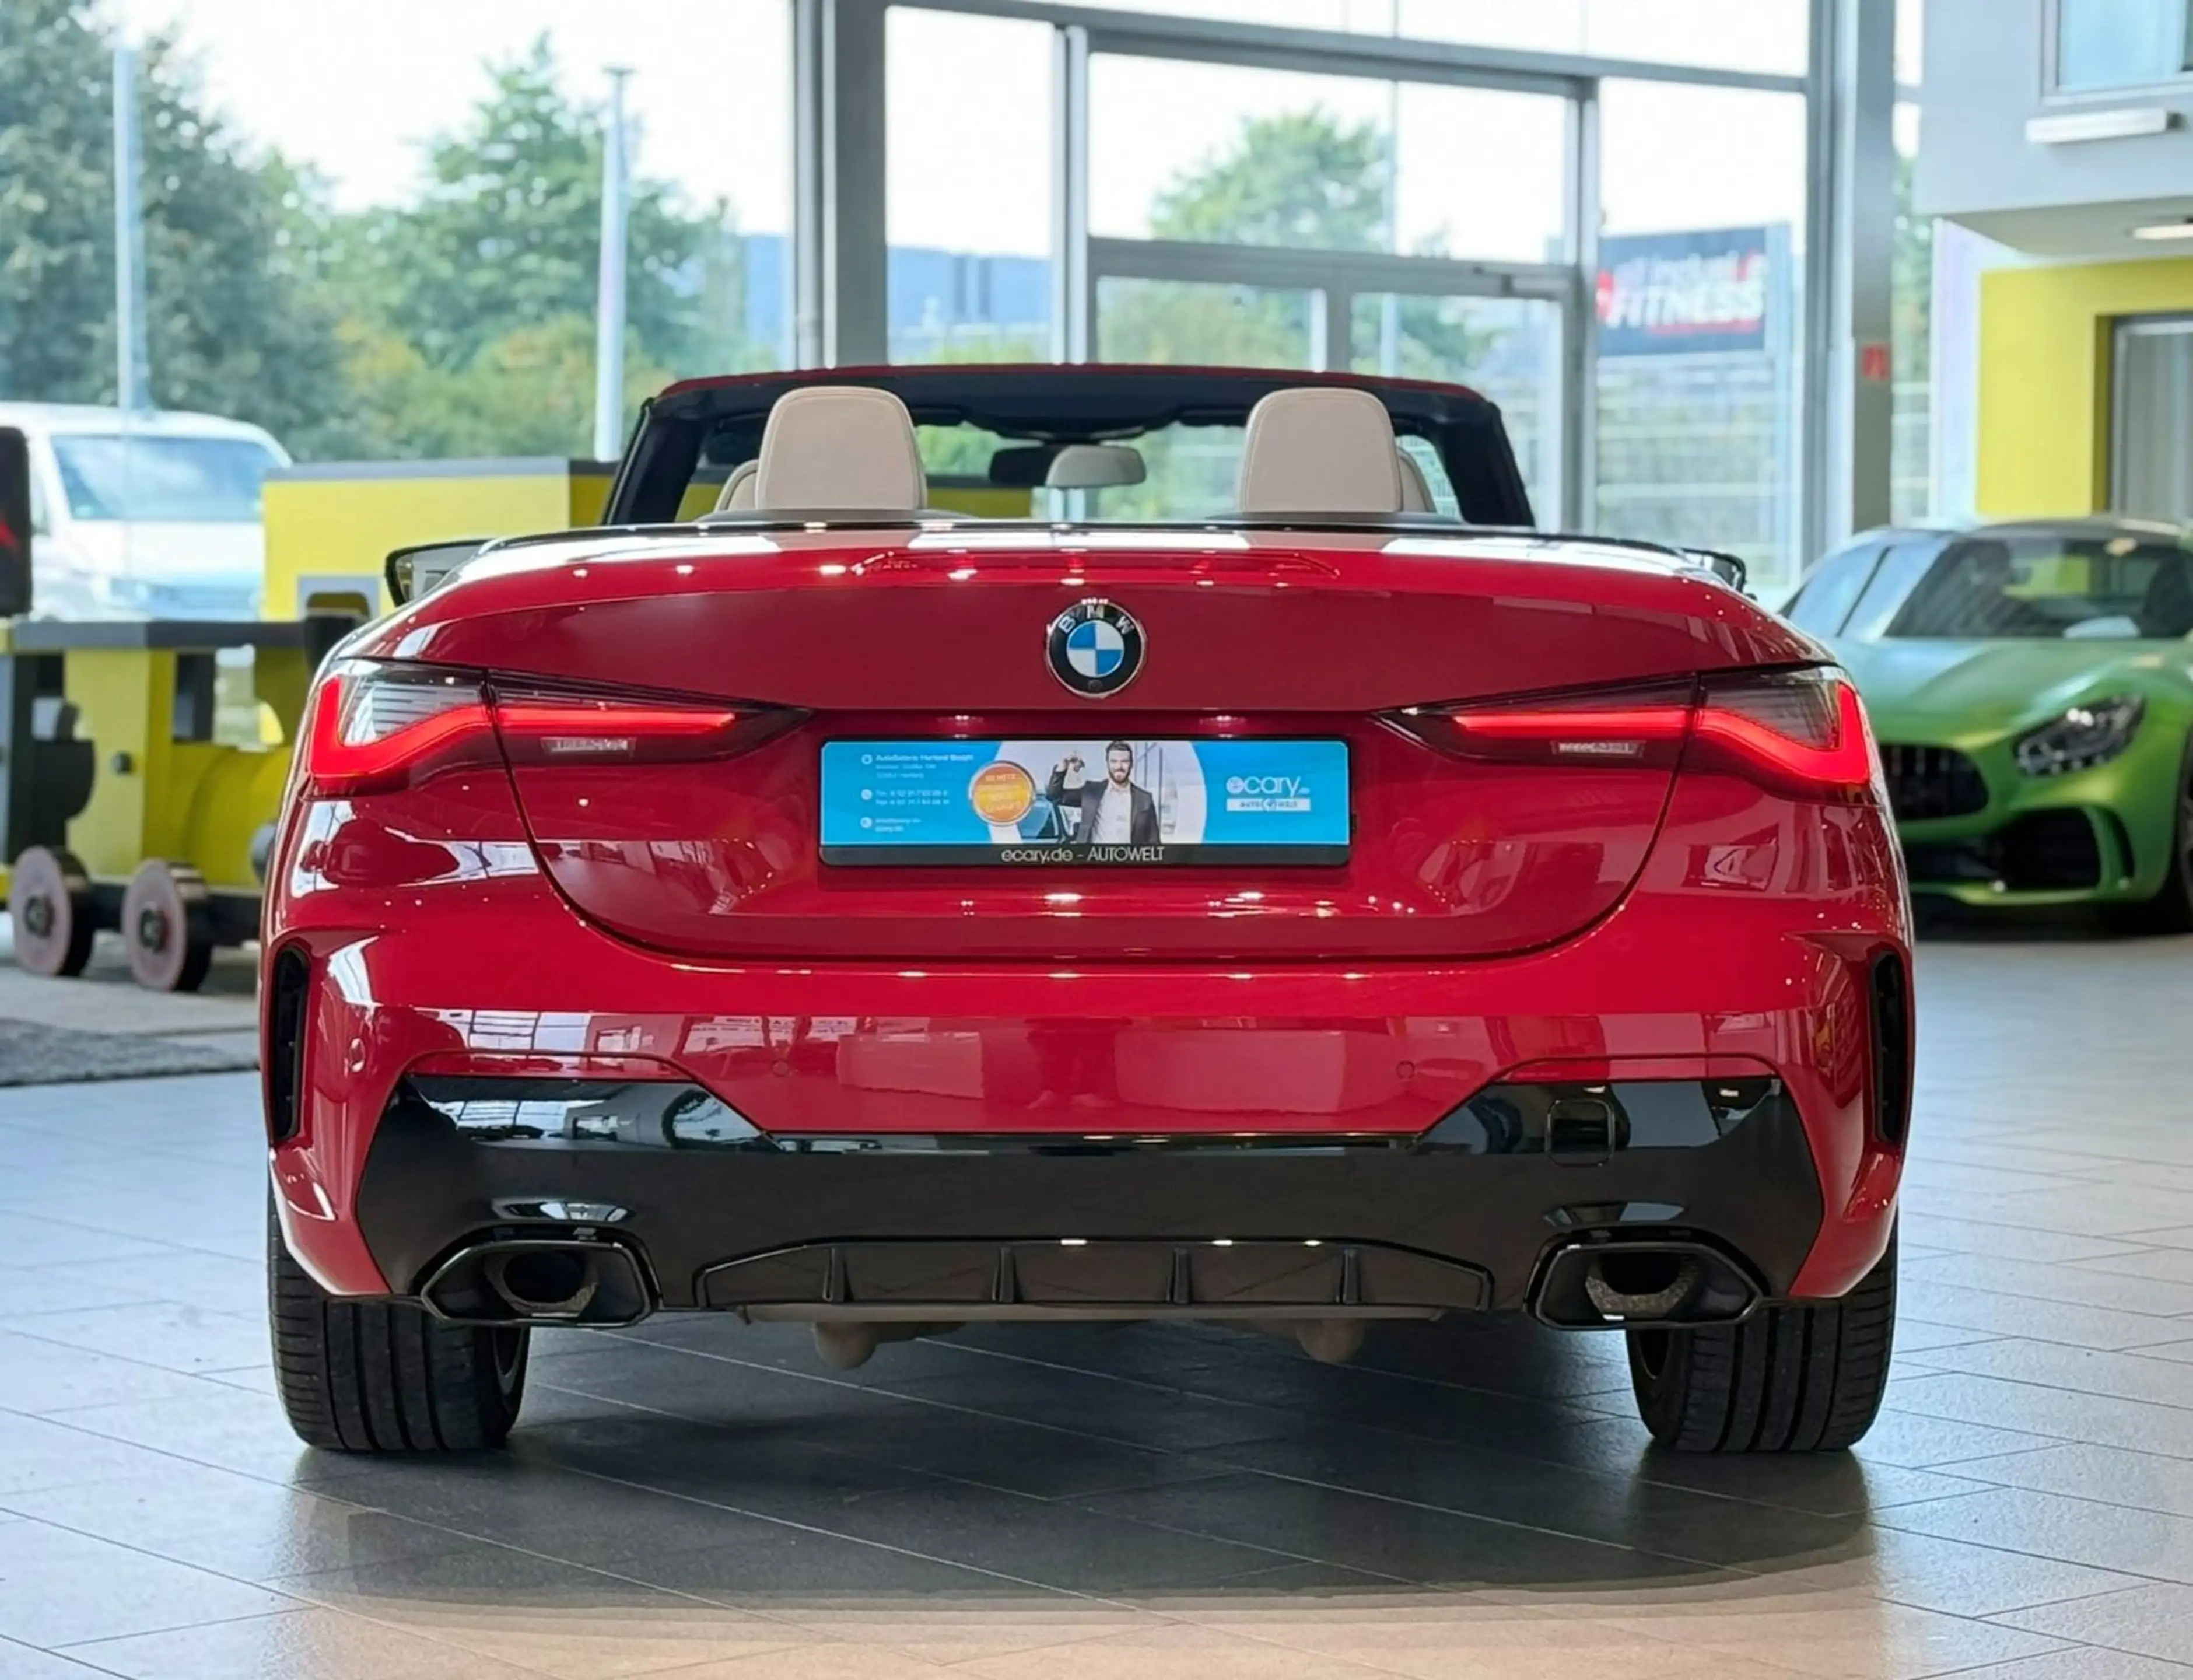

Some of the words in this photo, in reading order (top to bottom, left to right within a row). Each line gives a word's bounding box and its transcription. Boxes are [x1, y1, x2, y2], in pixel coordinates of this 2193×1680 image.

[1057, 604, 1135, 634] BMW
[1001, 848, 1073, 864] ecary.de
[1087, 846, 1165, 862] AUTOWELT
